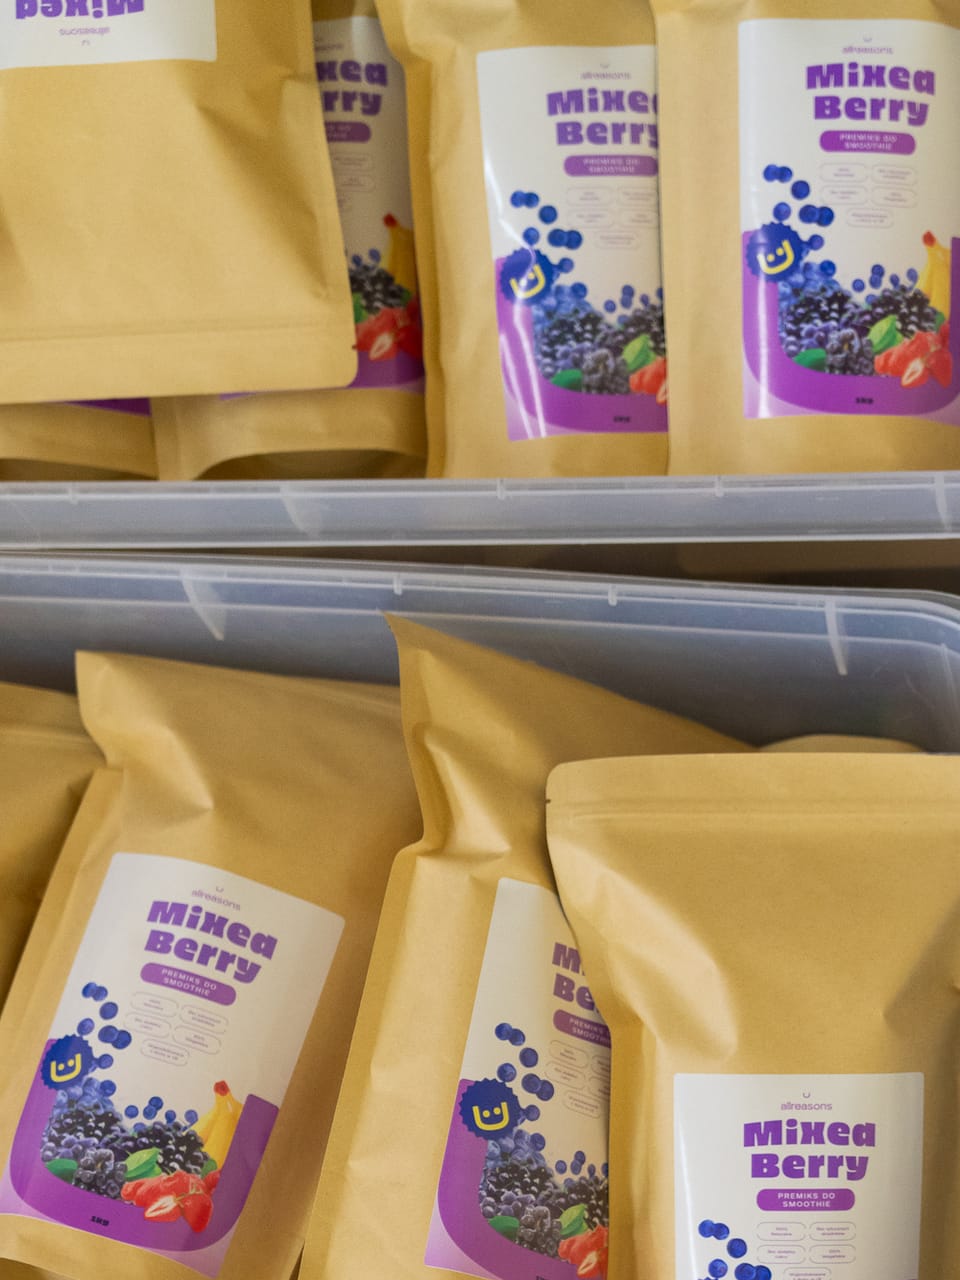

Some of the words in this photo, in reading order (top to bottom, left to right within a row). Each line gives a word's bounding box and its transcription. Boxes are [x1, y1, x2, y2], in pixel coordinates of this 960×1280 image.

[315, 60, 388, 87] xed
[806, 61, 935, 96] Mixed
[322, 90, 382, 116] rry
[546, 87, 658, 116] Mixe
[814, 95, 929, 127] Berry
[147, 900, 278, 961] Mixed
[144, 929, 262, 984] Berry
[161, 968, 201, 986] PREMIKS
[203, 981, 217, 991] DO
[163, 978, 211, 997] SMOOTHIE
[743, 1118, 876, 1147] Mixed
[751, 1153, 869, 1181] Berry
[777, 1192, 819, 1200] PREMIKS
[822, 1192, 836, 1200] DO
[782, 1200, 831, 1208] SMOOTHIE
